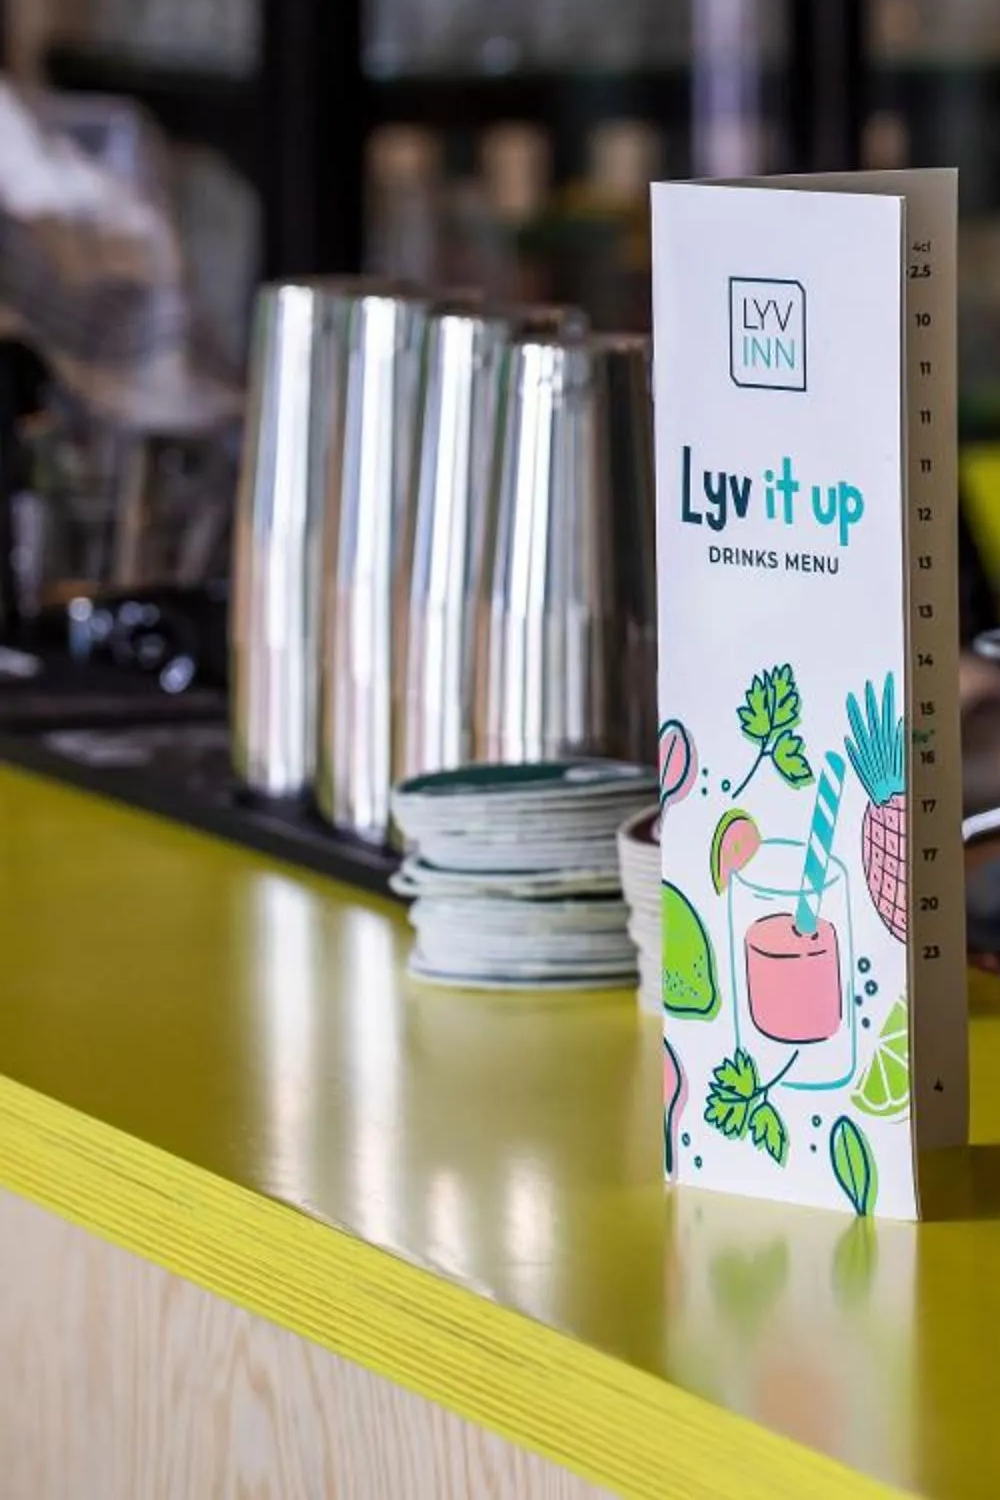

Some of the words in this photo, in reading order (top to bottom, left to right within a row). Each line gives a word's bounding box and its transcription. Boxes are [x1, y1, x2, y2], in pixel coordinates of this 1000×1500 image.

[743, 297, 793, 332] LYV
[914, 312, 931, 328] 10
[743, 336, 795, 369] INN
[682, 445, 752, 532] Lyv
[764, 456, 799, 525] it
[812, 481, 865, 546] up
[918, 507, 932, 521] 12
[709, 546, 778, 569] DRINKS
[785, 553, 839, 575] MENU
[918, 555, 932, 570] 13
[918, 603, 933, 619] 13
[917, 653, 934, 668] 14
[920, 701, 935, 716] 15
[920, 749, 935, 765] 16
[921, 799, 936, 813] 17
[922, 848, 938, 862] 17
[920, 896, 939, 911] 20
[922, 945, 941, 960] 23
